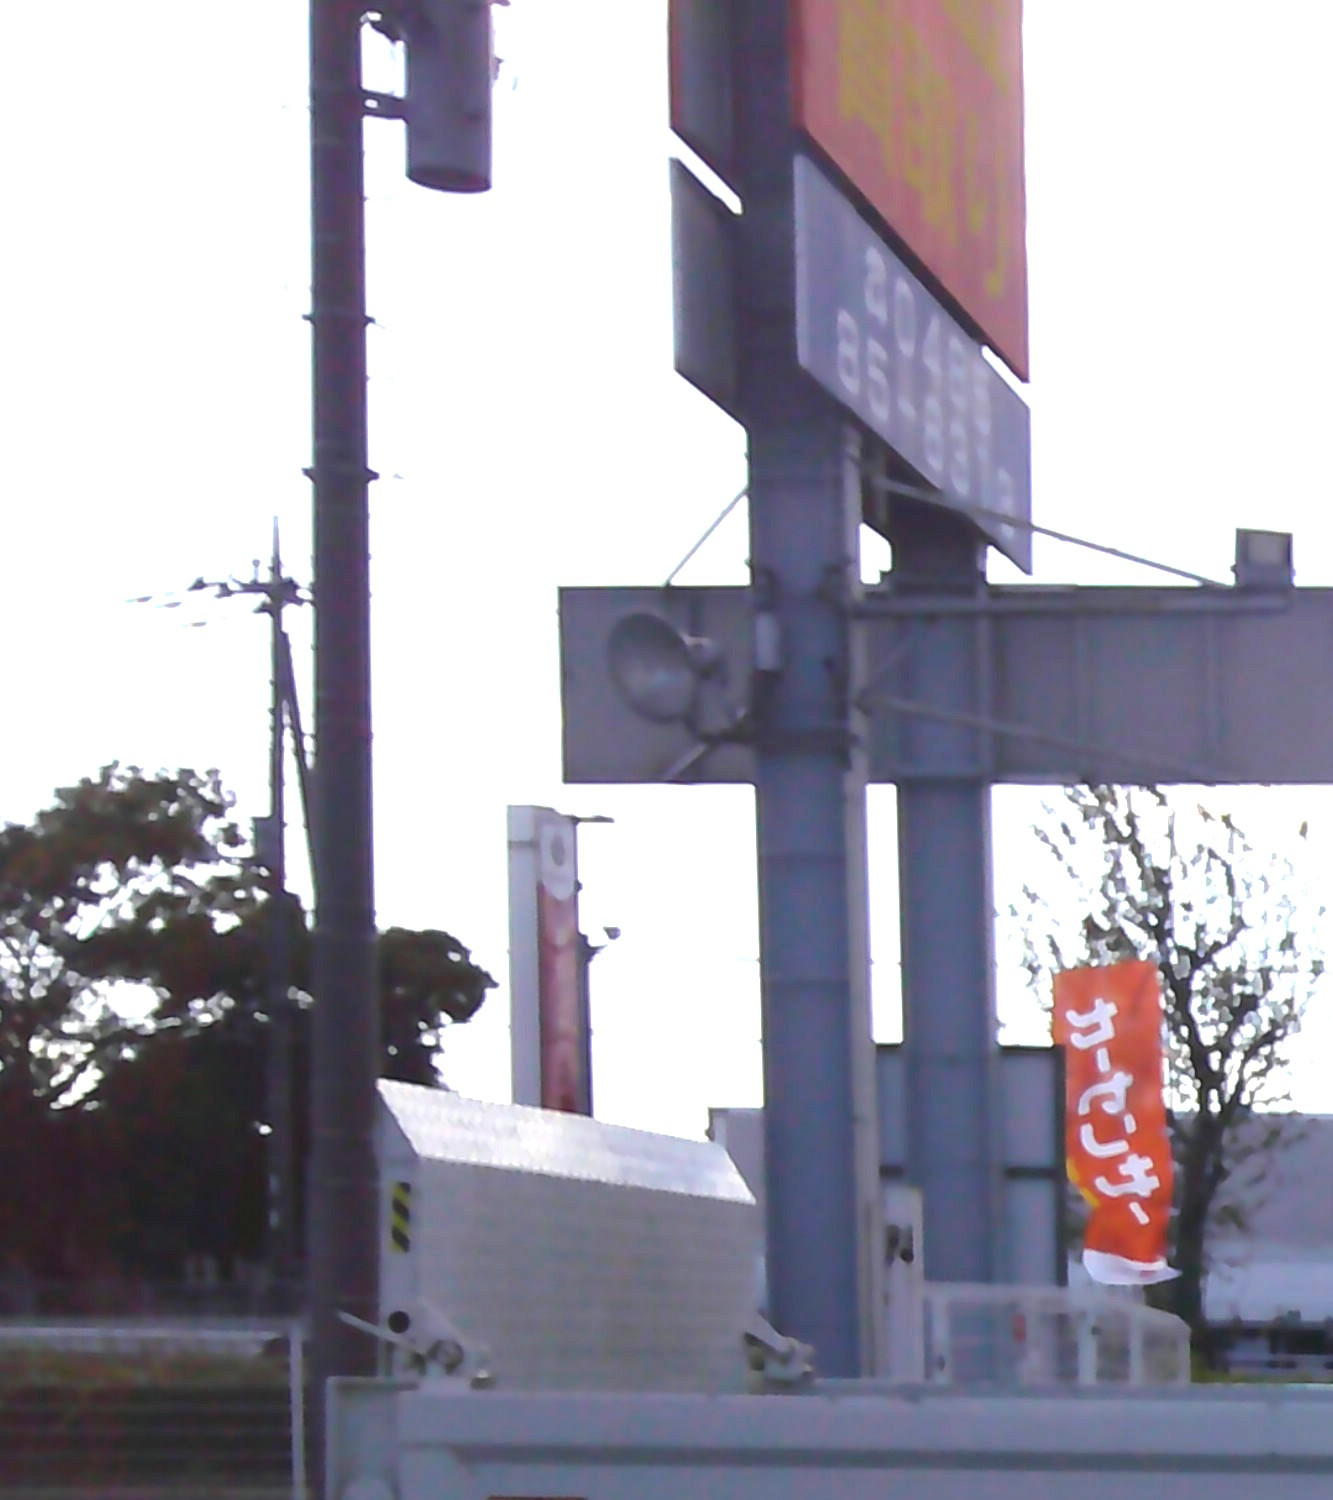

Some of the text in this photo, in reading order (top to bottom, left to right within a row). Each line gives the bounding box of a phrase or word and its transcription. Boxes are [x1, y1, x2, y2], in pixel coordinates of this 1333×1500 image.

[1064, 997, 1161, 1226] カーセンサー
